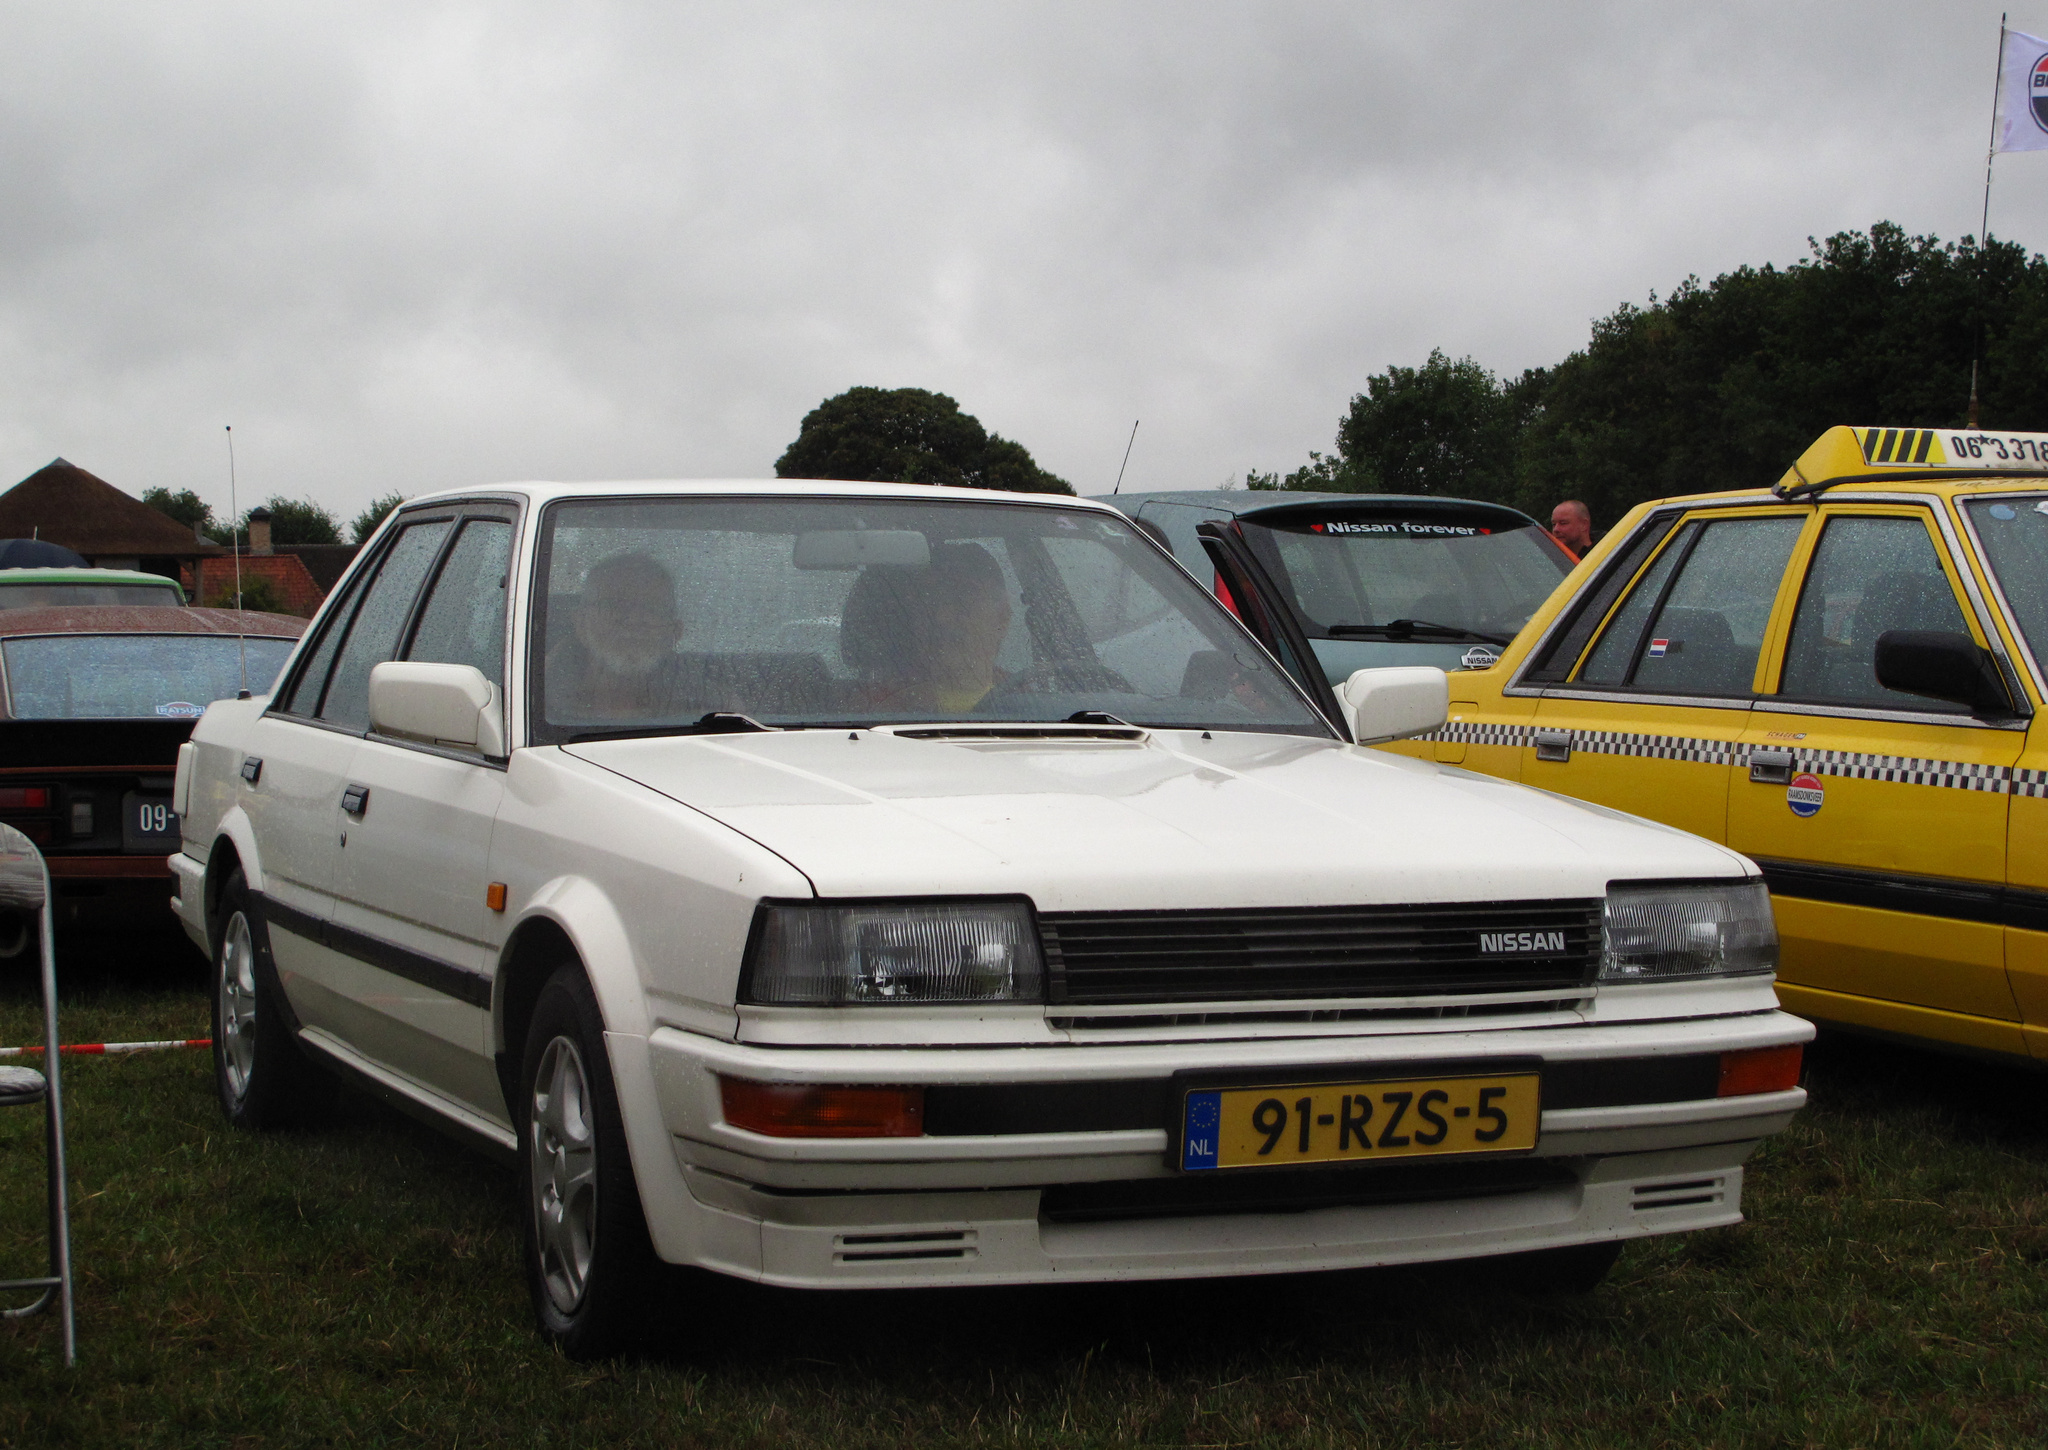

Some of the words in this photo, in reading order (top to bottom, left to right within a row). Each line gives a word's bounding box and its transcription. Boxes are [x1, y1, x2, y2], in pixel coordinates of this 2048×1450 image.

[1327, 522, 1397, 533] Nissan
[1401, 522, 1475, 535] forever
[1467, 657, 1498, 665] NISSAN
[1480, 932, 1565, 952] NISSAN
[1252, 1087, 1508, 1155] 91-RZS-5
[1189, 1139, 1214, 1156] NL
